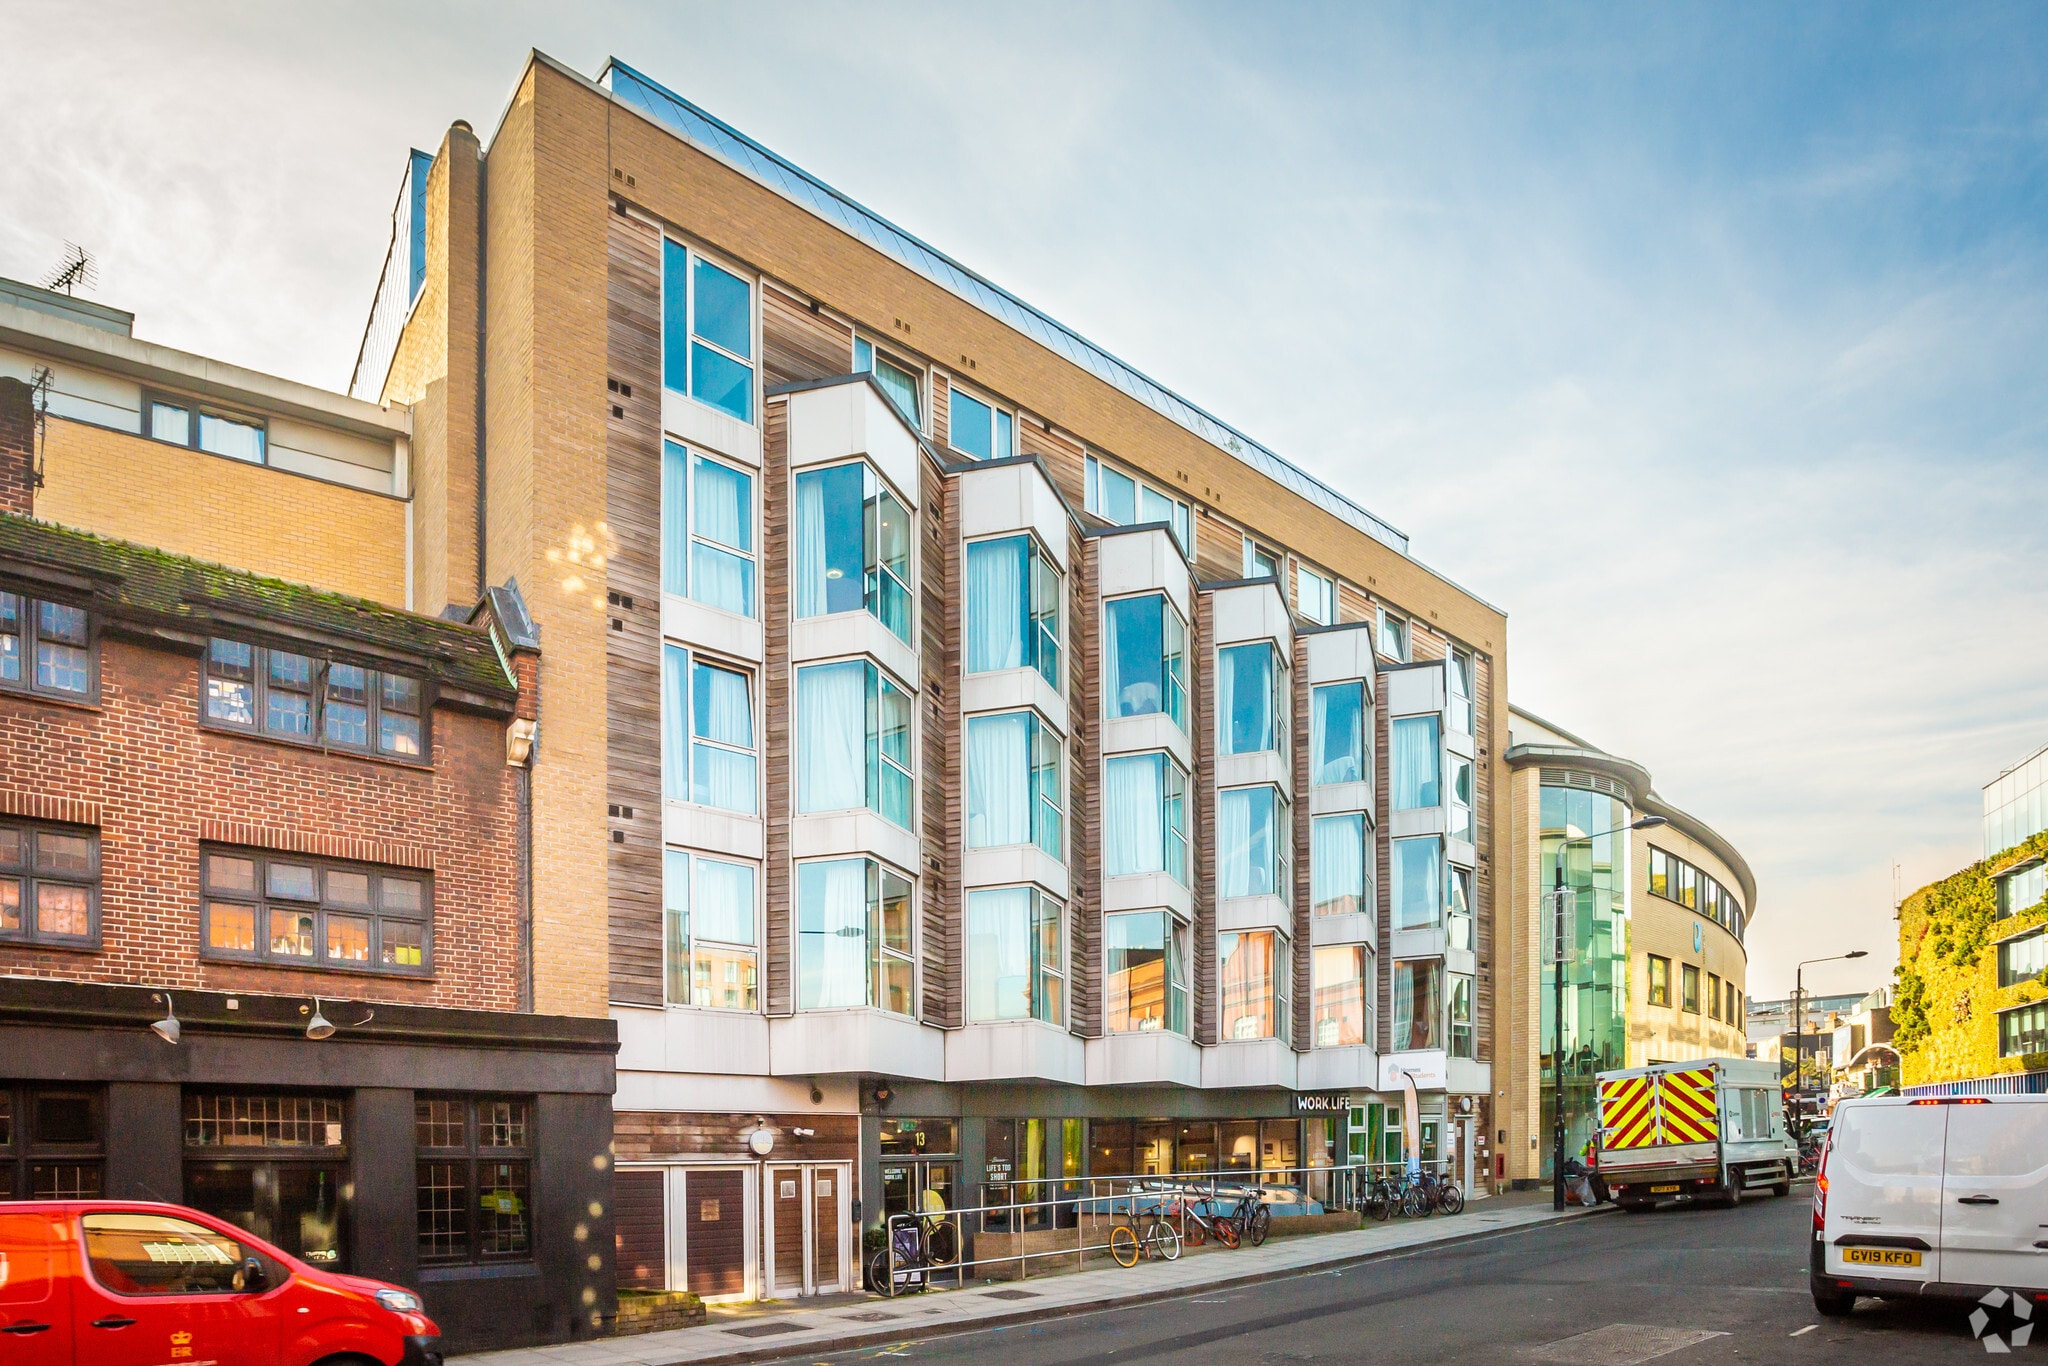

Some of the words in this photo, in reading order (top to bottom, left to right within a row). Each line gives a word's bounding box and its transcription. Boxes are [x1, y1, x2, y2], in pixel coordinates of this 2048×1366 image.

[1297, 1096, 1350, 1110] WORK.LIFE
[915, 1132, 925, 1146] 13
[986, 1164, 1001, 1172] LIFE'S
[990, 1173, 1007, 1181] SHORT
[1851, 1250, 1881, 1262] GV19
[1885, 1252, 1912, 1264] KFO
[171, 1347, 192, 1357] ER
